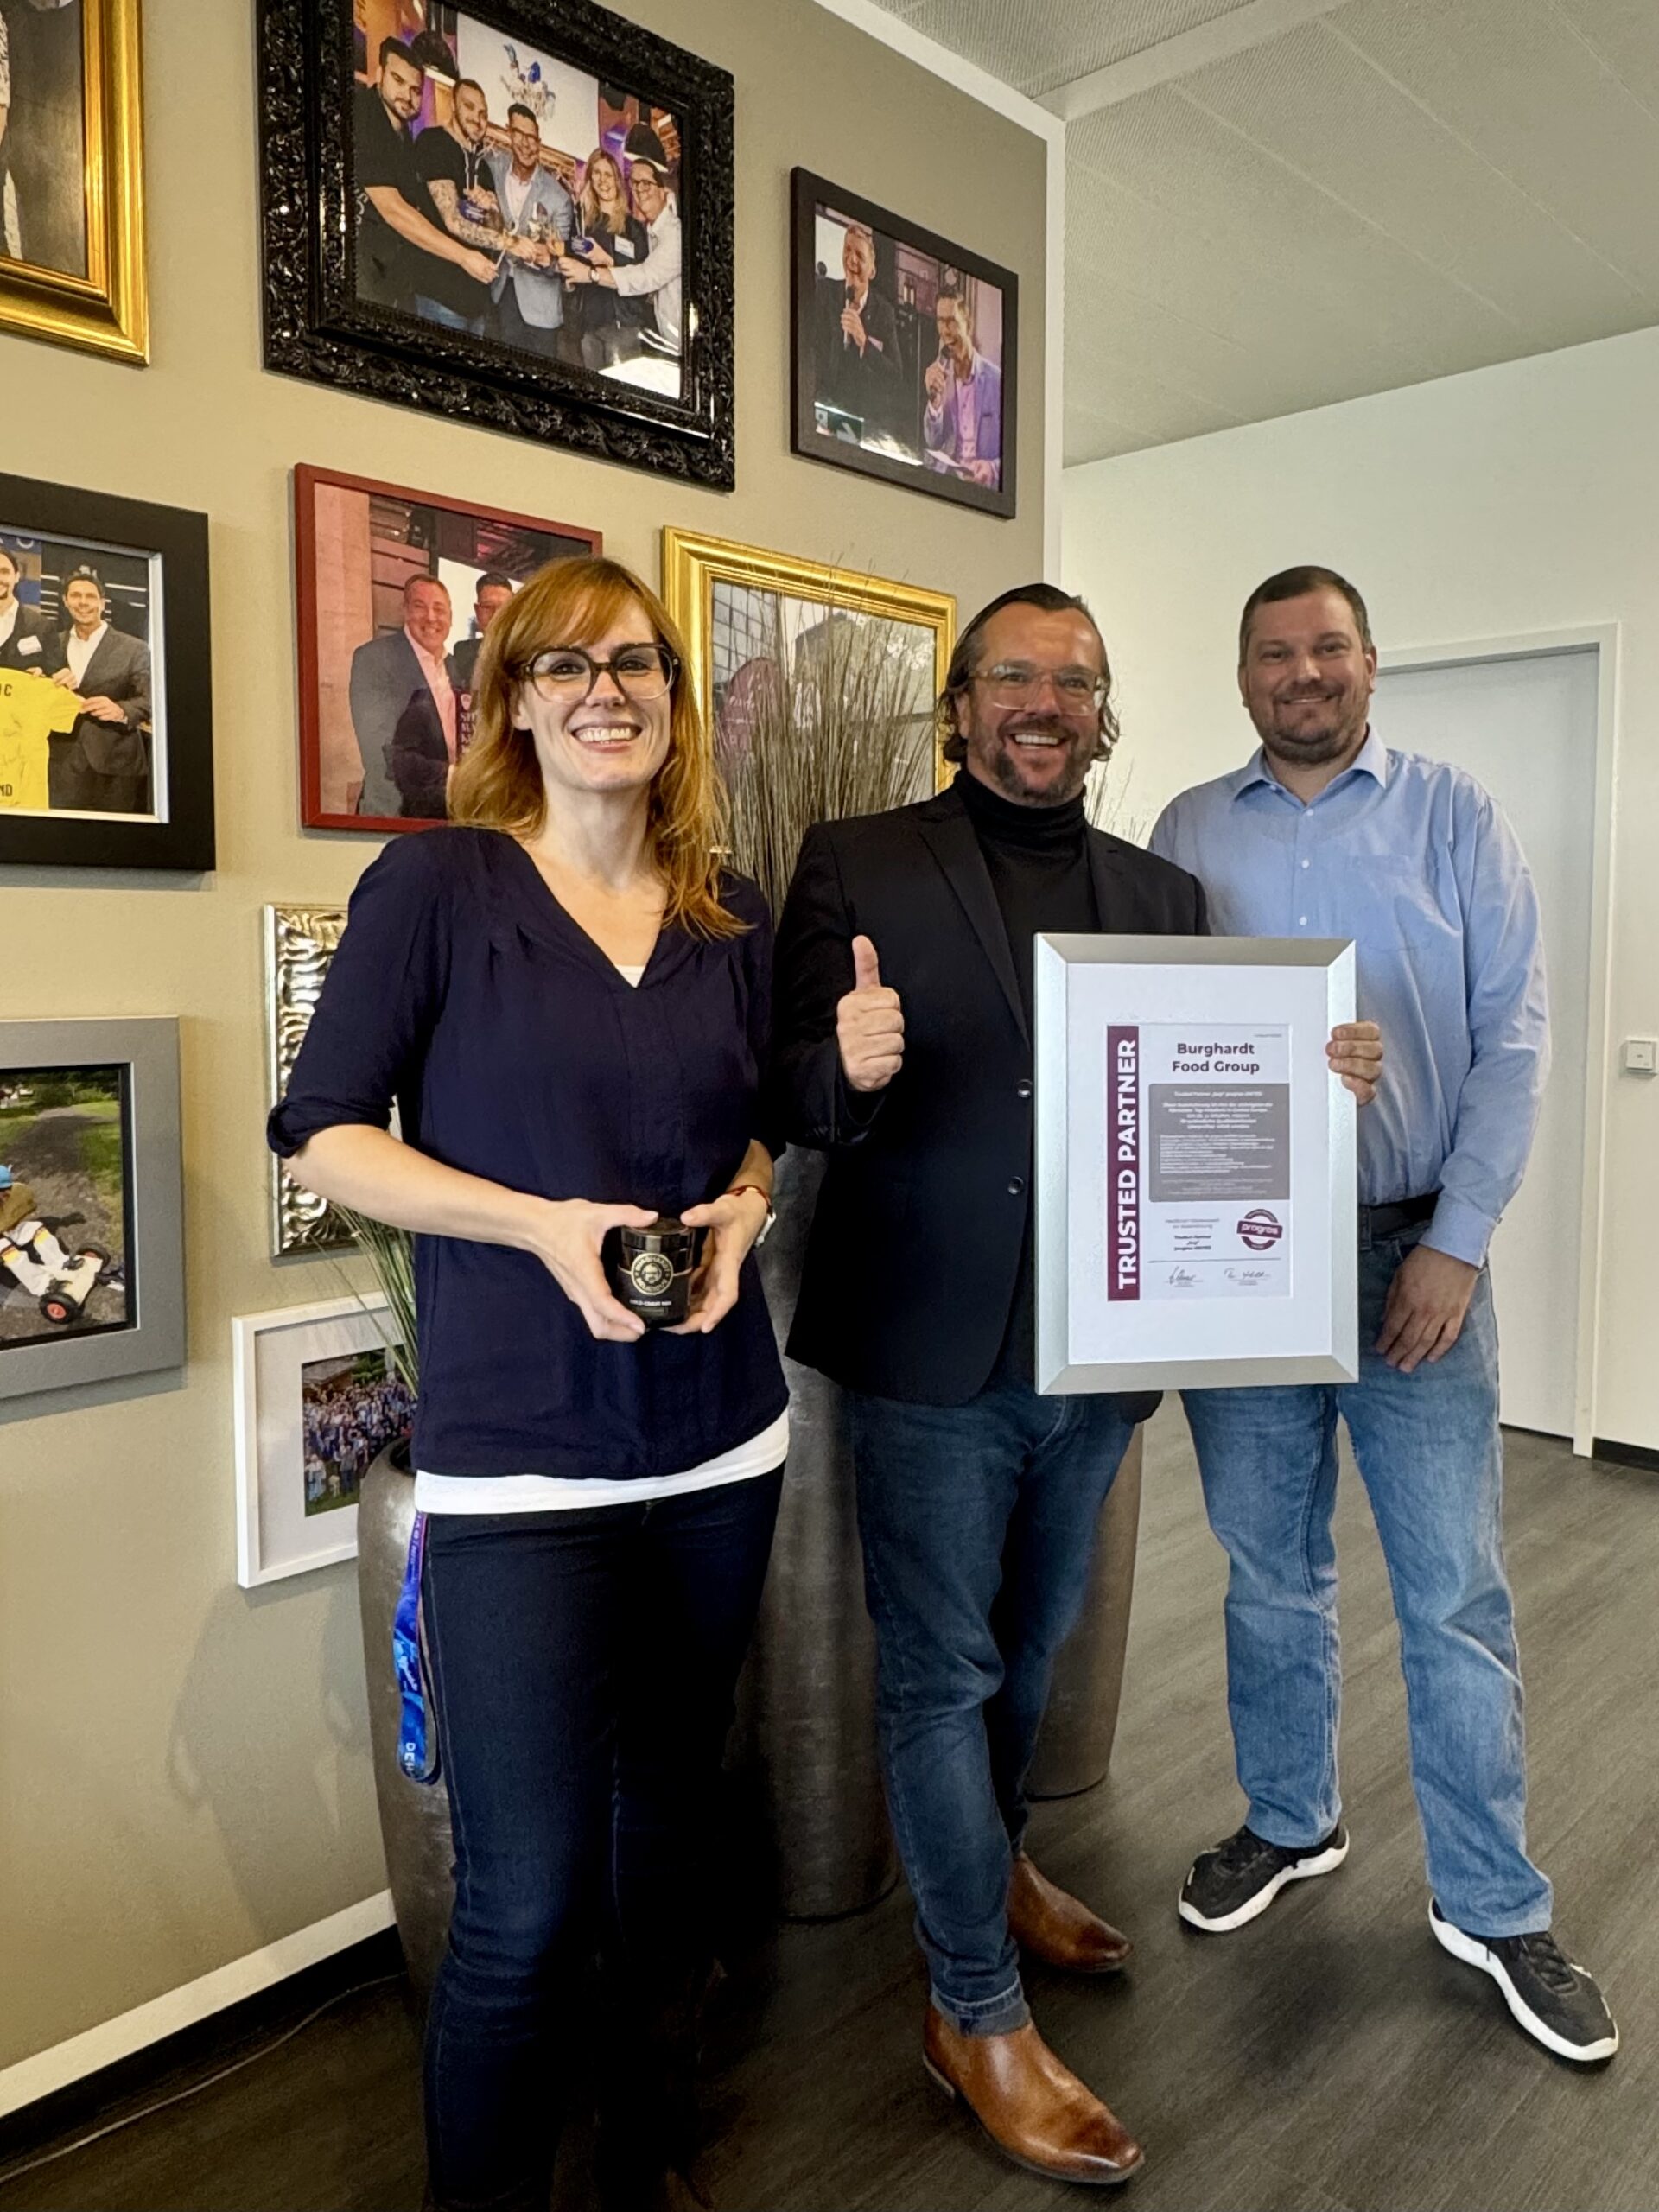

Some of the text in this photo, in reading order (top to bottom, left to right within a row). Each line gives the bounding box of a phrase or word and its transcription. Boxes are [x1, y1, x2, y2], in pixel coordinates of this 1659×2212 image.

[1177, 1042, 1255, 1058] Burghardt
[1172, 1060, 1260, 1075] Food Group
[1117, 1039, 1136, 1289] TRUSTED PARTNER
[1241, 1224, 1279, 1235] progros
